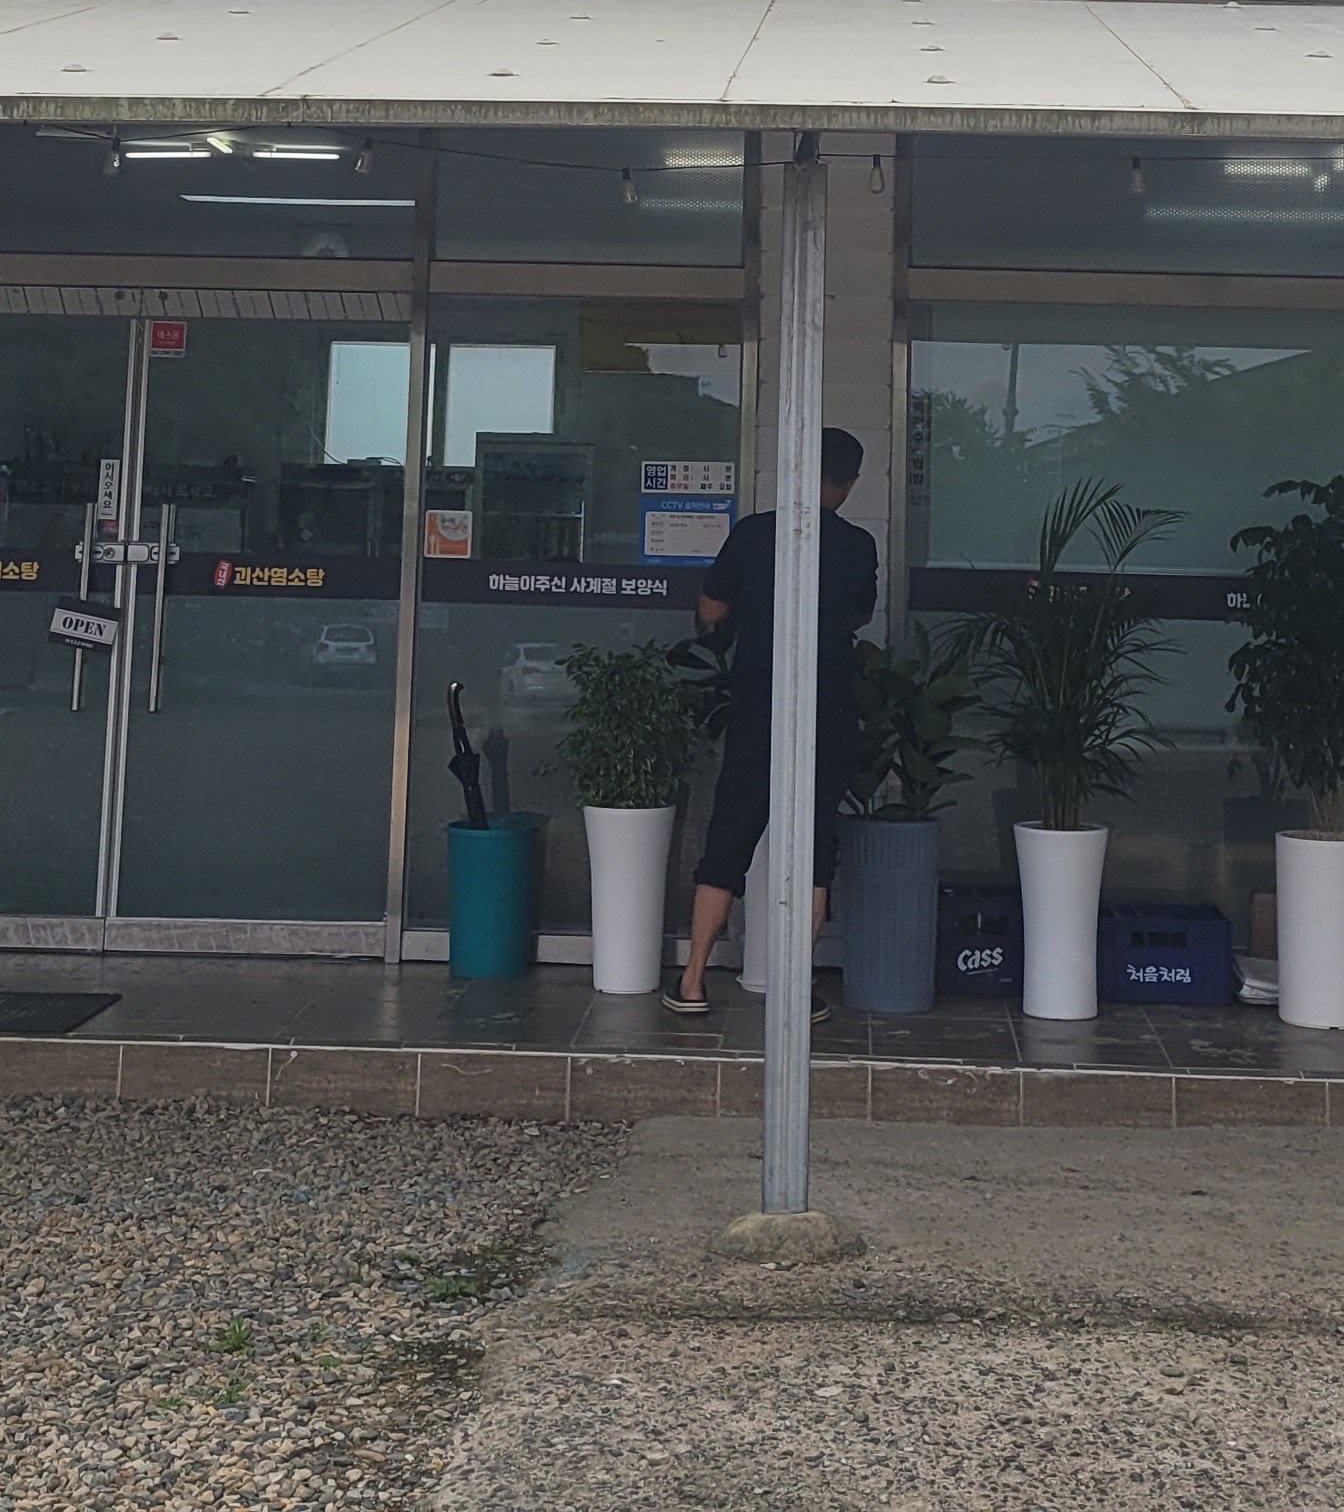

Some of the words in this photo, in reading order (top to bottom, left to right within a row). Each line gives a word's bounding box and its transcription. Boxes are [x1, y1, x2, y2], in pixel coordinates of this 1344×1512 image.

[233, 566, 326, 587] 괴산염소탕
[488, 573, 567, 593] 하늘이주신
[569, 576, 617, 595] 사계절
[620, 577, 668, 597] 보양식
[62, 616, 107, 637] OPEN
[956, 946, 1004, 972] Cass
[1125, 963, 1192, 984] 처음처럼
